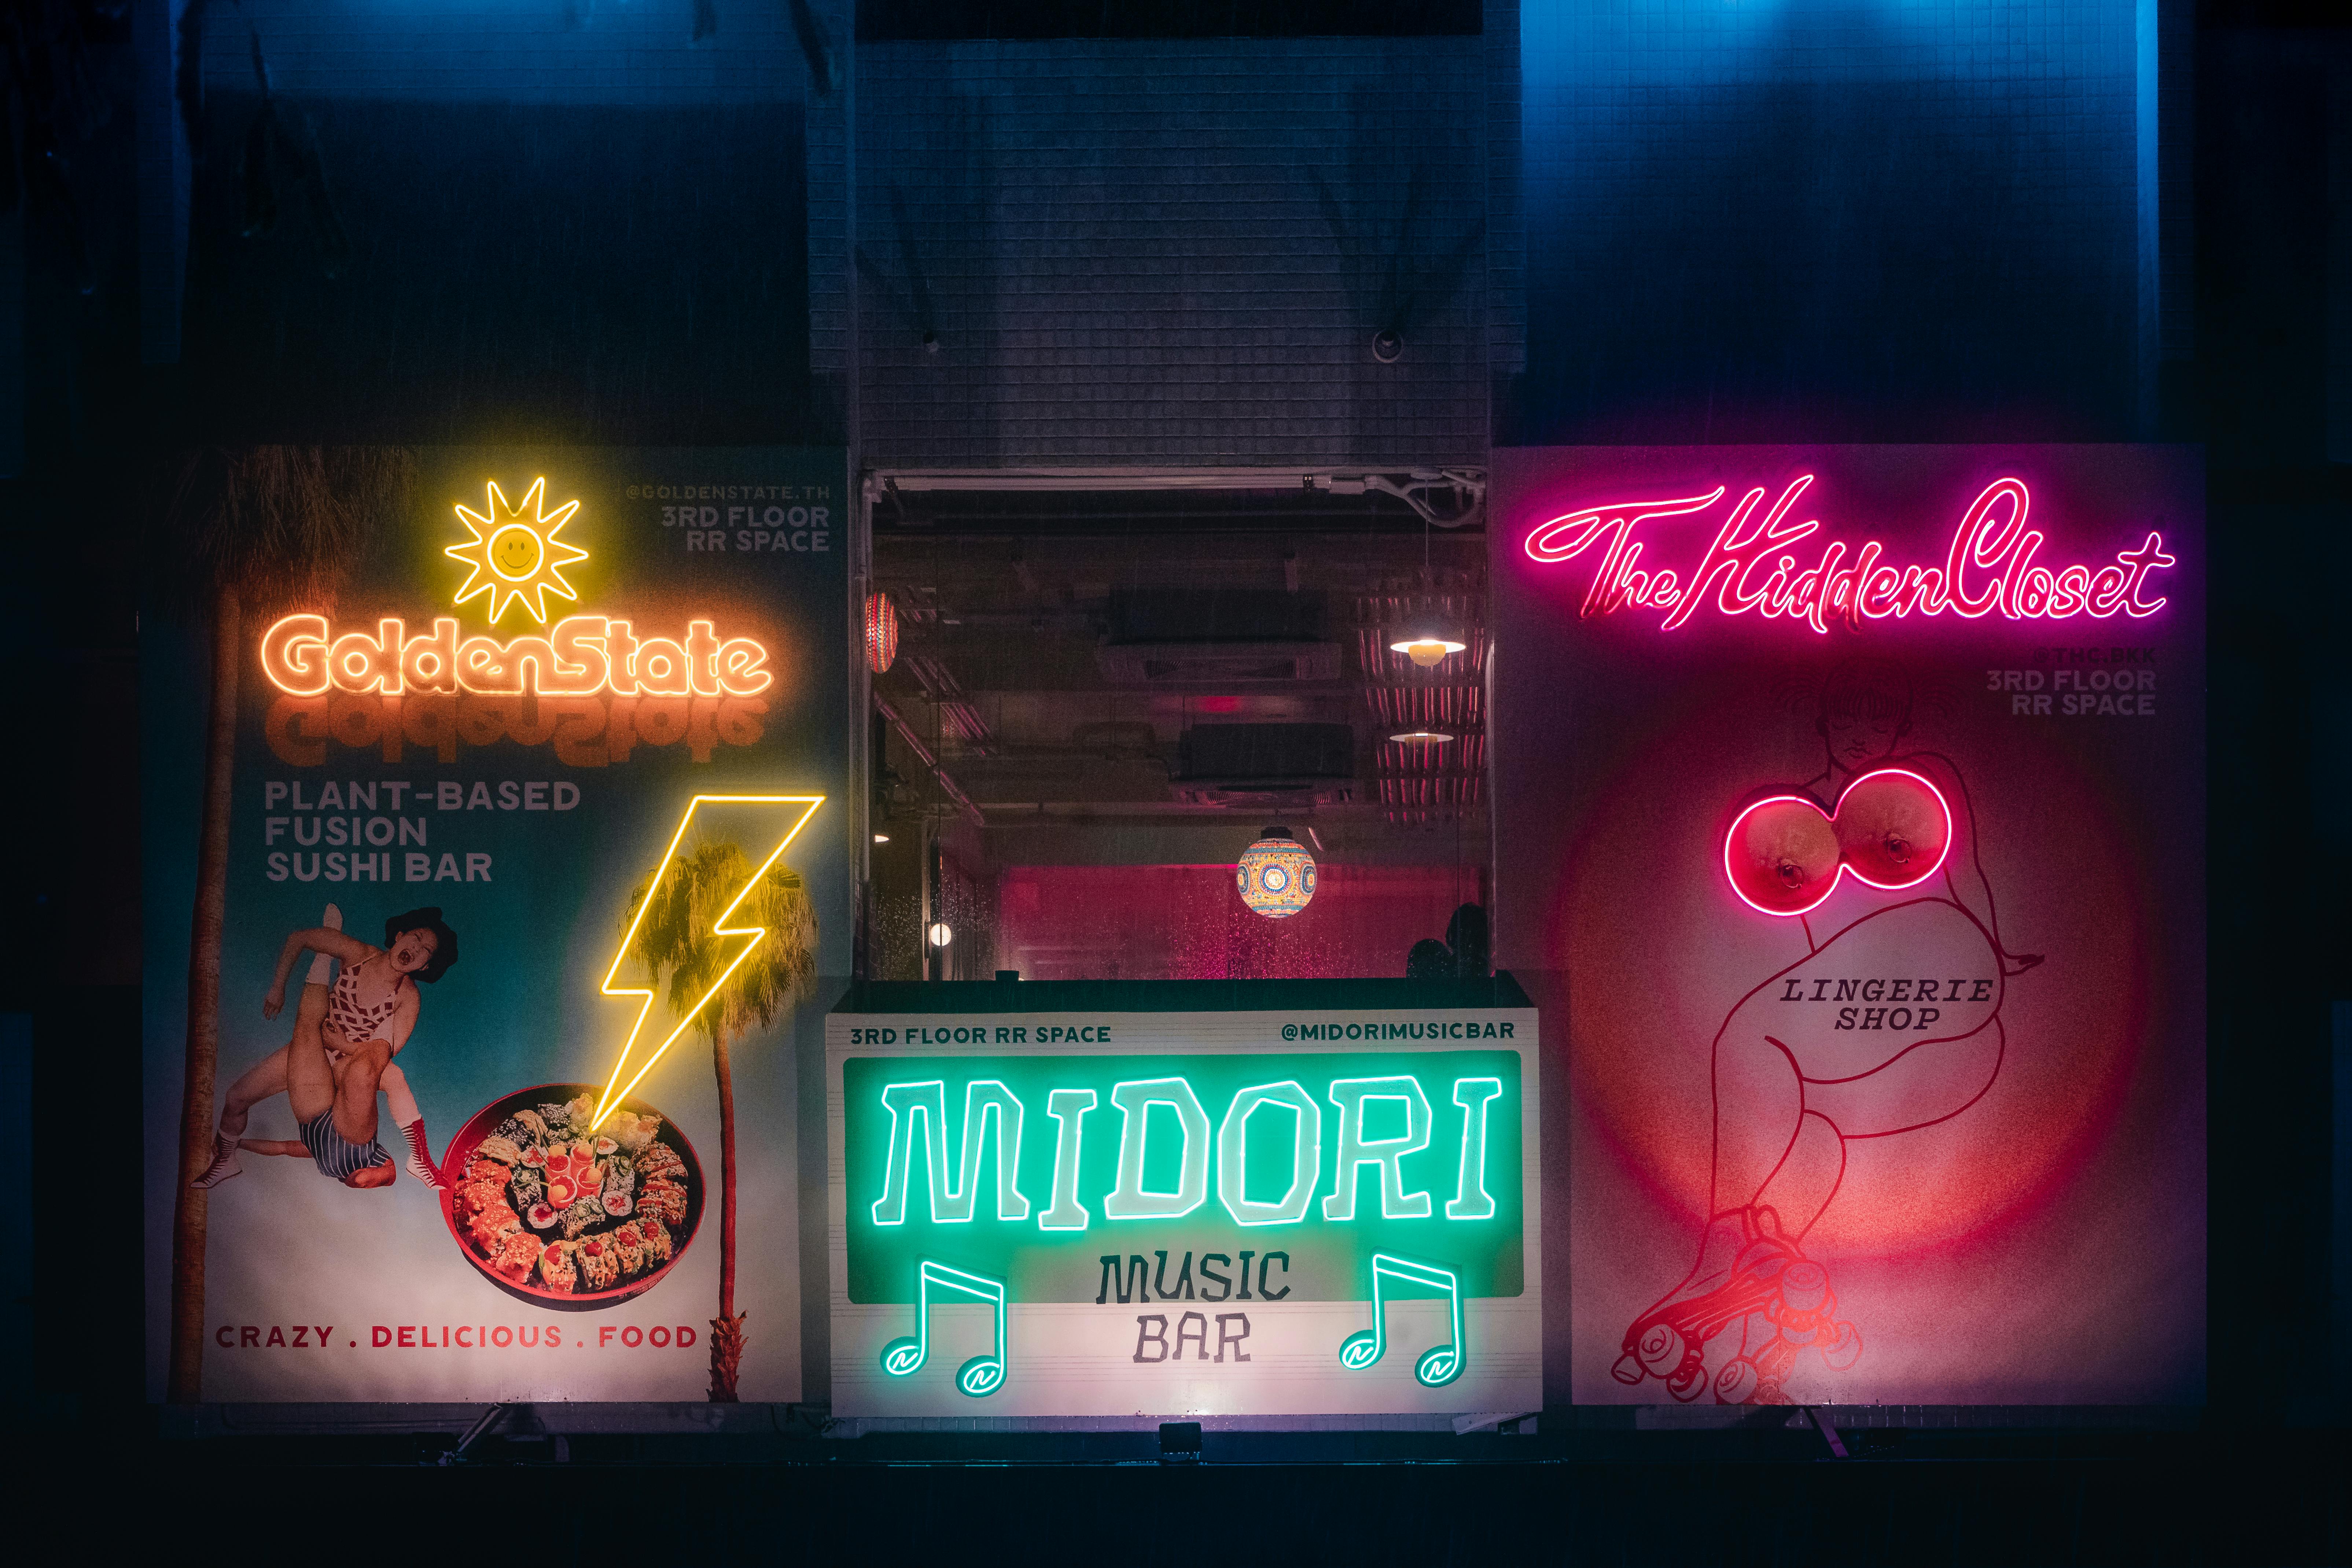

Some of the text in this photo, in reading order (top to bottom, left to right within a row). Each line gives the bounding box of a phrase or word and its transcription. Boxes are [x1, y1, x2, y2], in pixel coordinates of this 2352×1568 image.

[626, 485, 829, 500] @GOLDENSTATE.TH
[662, 506, 829, 527] 3RD FLOOR
[687, 531, 829, 551] RR SPACE
[1525, 474, 2176, 633] The Hidden Closet
[2033, 647, 2156, 663] @THC.BKK
[1987, 670, 2156, 691] 3RD FLOOR
[2012, 693, 2156, 715] RR SPACE
[265, 781, 581, 811] PLANT-BASED
[265, 817, 427, 846] FUSION
[265, 852, 492, 883] SUSHI BAR
[1779, 979, 1993, 1002] LINGERIE
[1834, 1007, 1940, 1030] SHOP
[851, 1026, 1111, 1045] 3RD FLOOR RR SPACE
[1281, 1022, 1515, 1041] @MIDORIMUSICBAR
[871, 1075, 1503, 1232] MIDORI
[1096, 1250, 1291, 1304] MUSIC
[216, 1325, 334, 1348] CRAZY
[372, 1325, 562, 1348] DELICIOUS
[599, 1325, 697, 1348] FOOD
[1133, 1311, 1252, 1363] BAR
